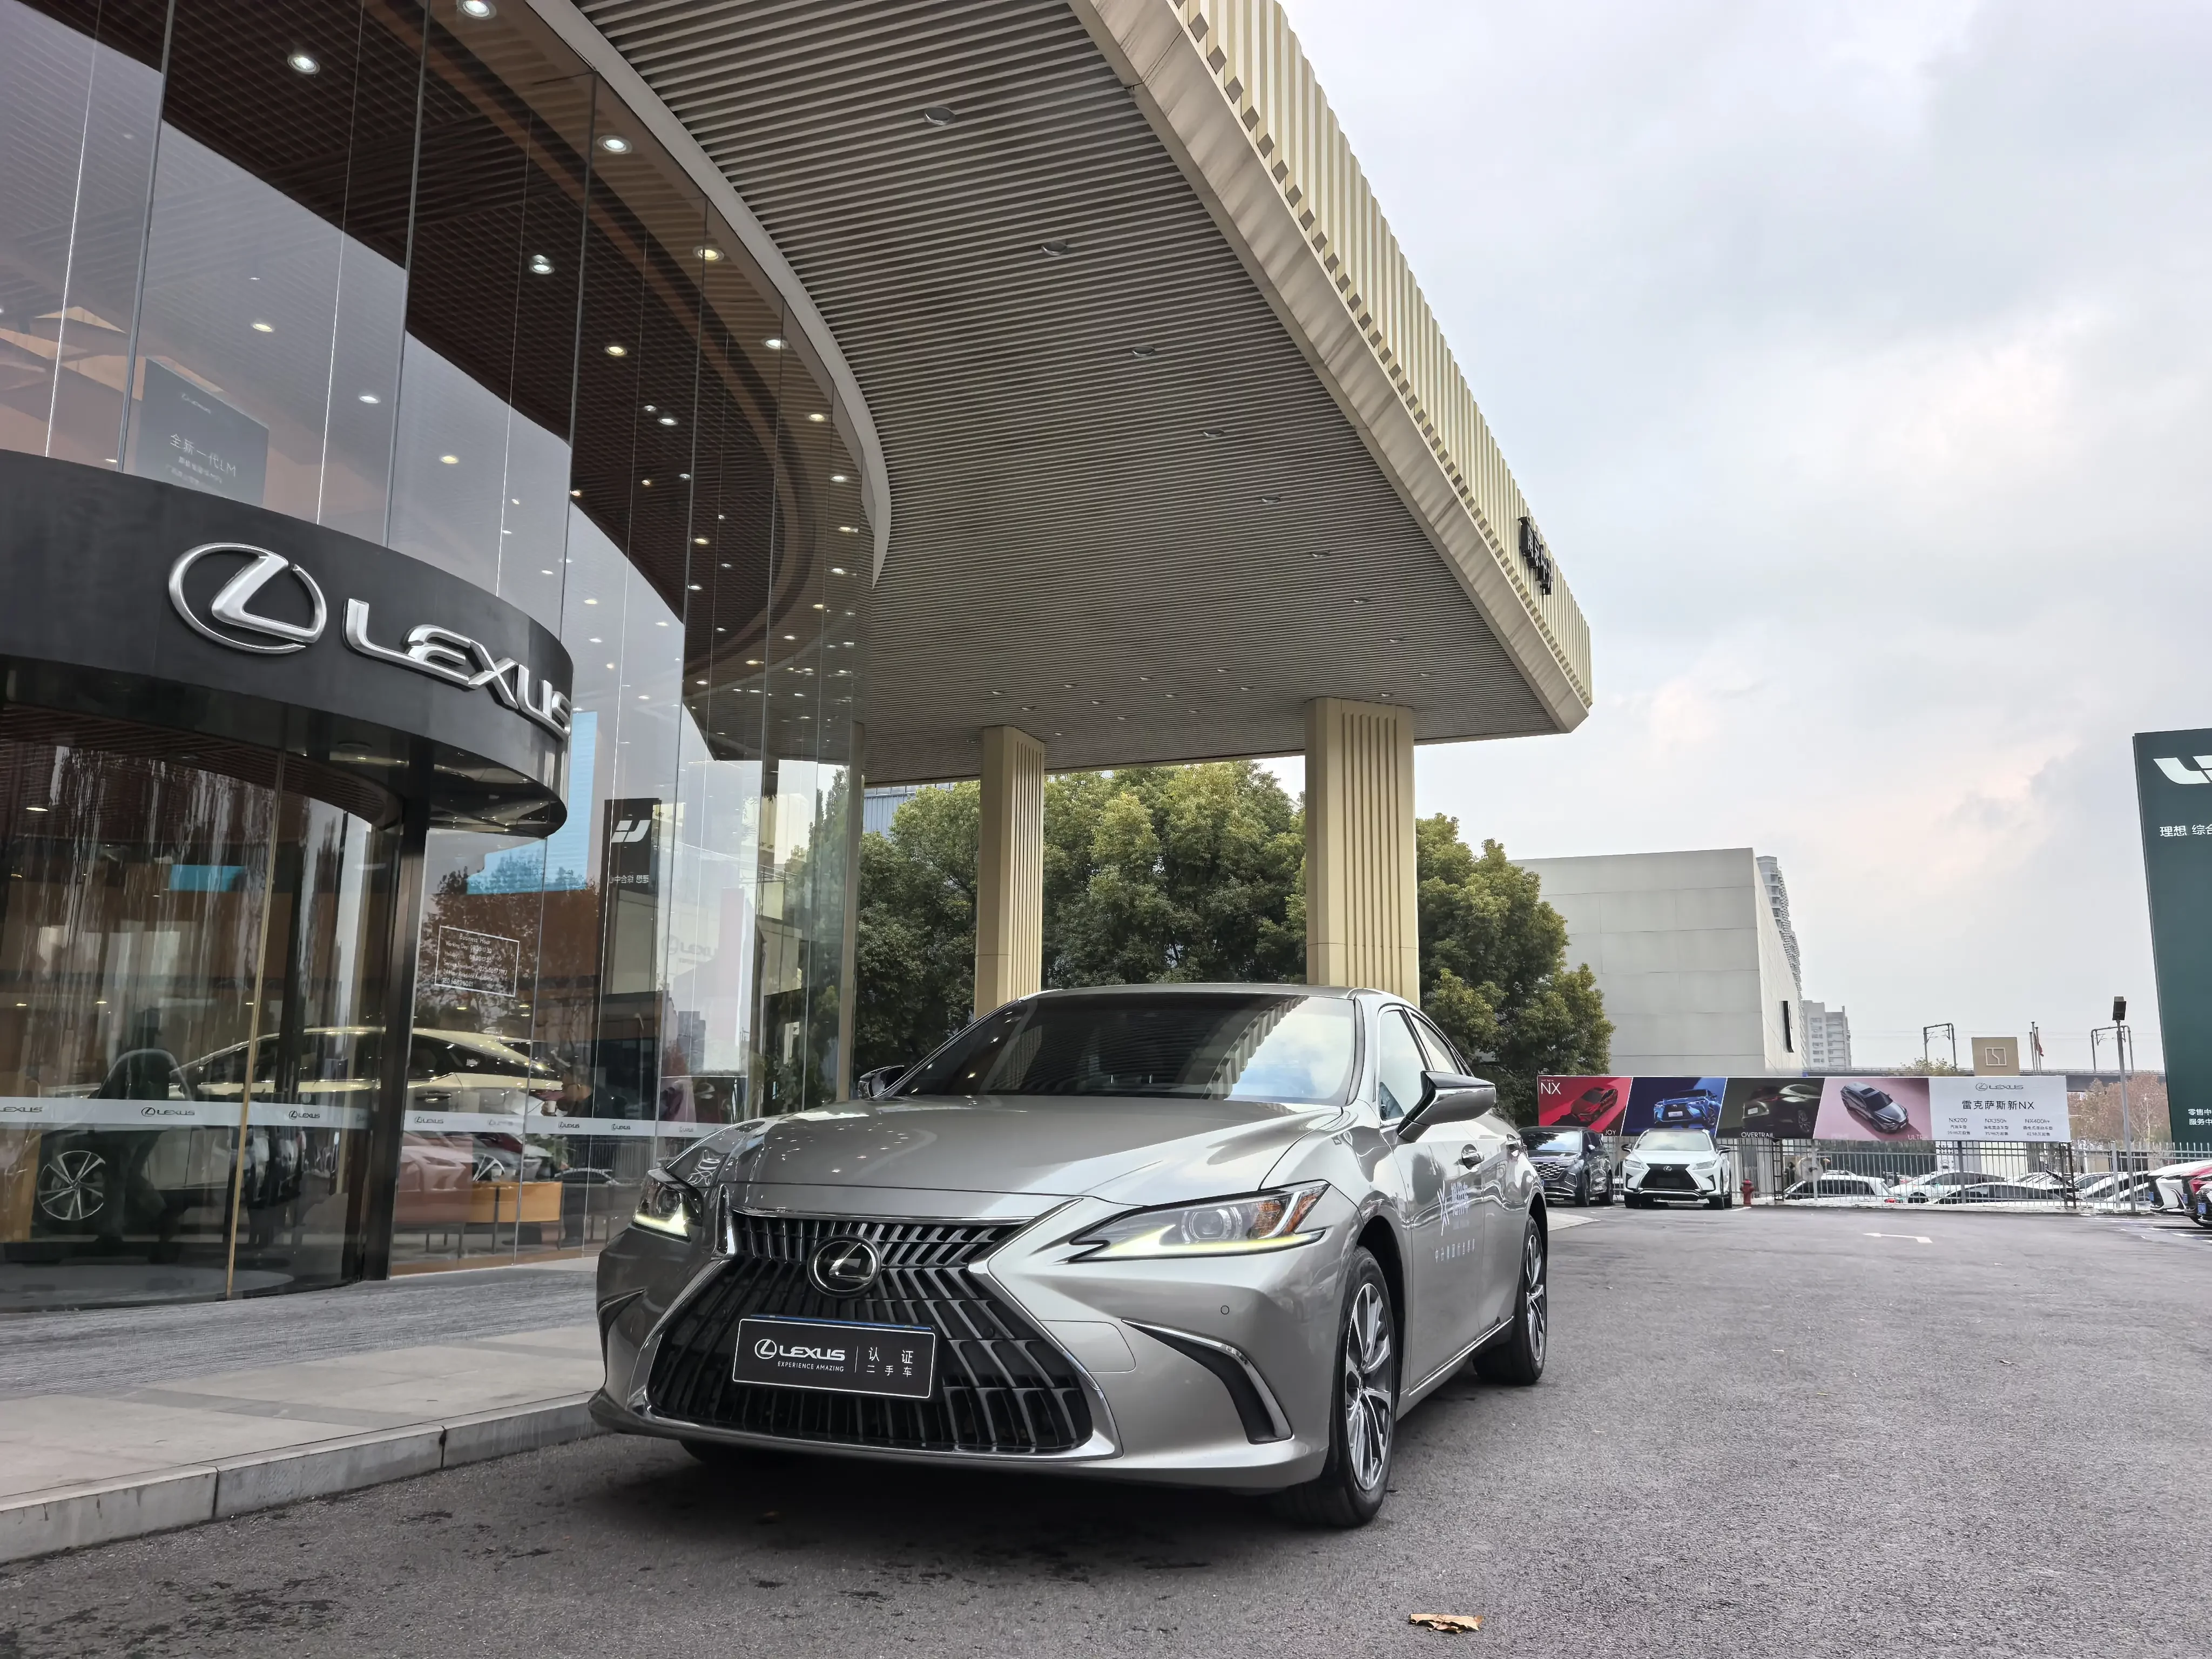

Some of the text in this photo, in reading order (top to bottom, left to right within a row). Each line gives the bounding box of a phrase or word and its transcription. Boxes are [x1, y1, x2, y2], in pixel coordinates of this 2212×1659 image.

[345, 598, 571, 740] LEXUS
[2160, 825, 2187, 837] 理想
[1541, 1082, 1561, 1095] NX
[1962, 1100, 2035, 1110] 雷克萨斯新NX
[779, 1345, 846, 1361] LEXUS
[868, 1347, 914, 1364] 认证
[777, 1361, 845, 1372] EXPERIENCE AMAZING
[866, 1365, 913, 1378] 二手车
